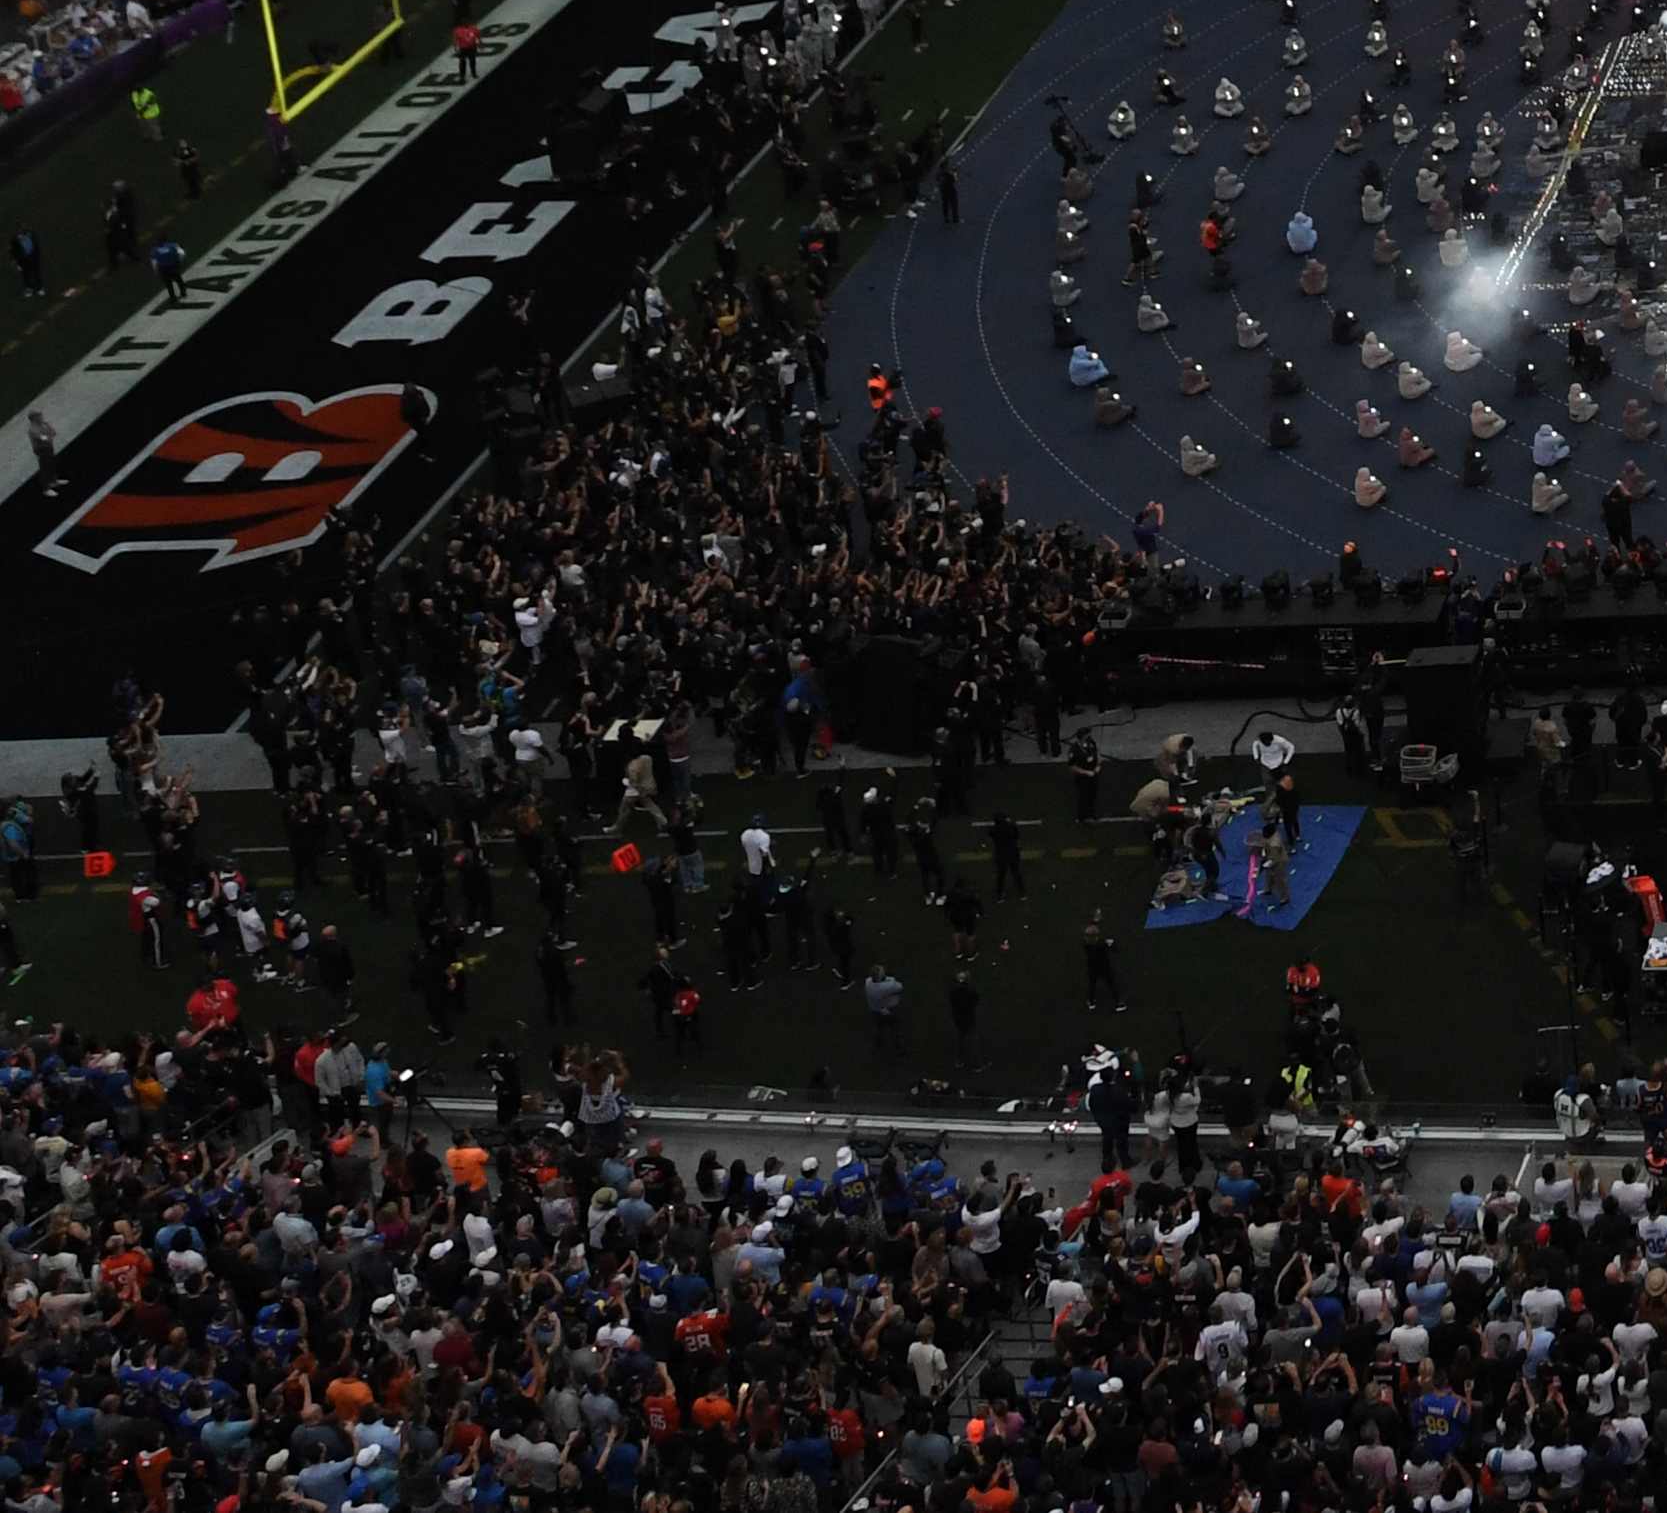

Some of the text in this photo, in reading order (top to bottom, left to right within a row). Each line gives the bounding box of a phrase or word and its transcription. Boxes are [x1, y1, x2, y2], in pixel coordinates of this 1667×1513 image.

[84, 336, 170, 374] IT
[150, 199, 328, 318] TAKES
[311, 123, 416, 185] ALL
